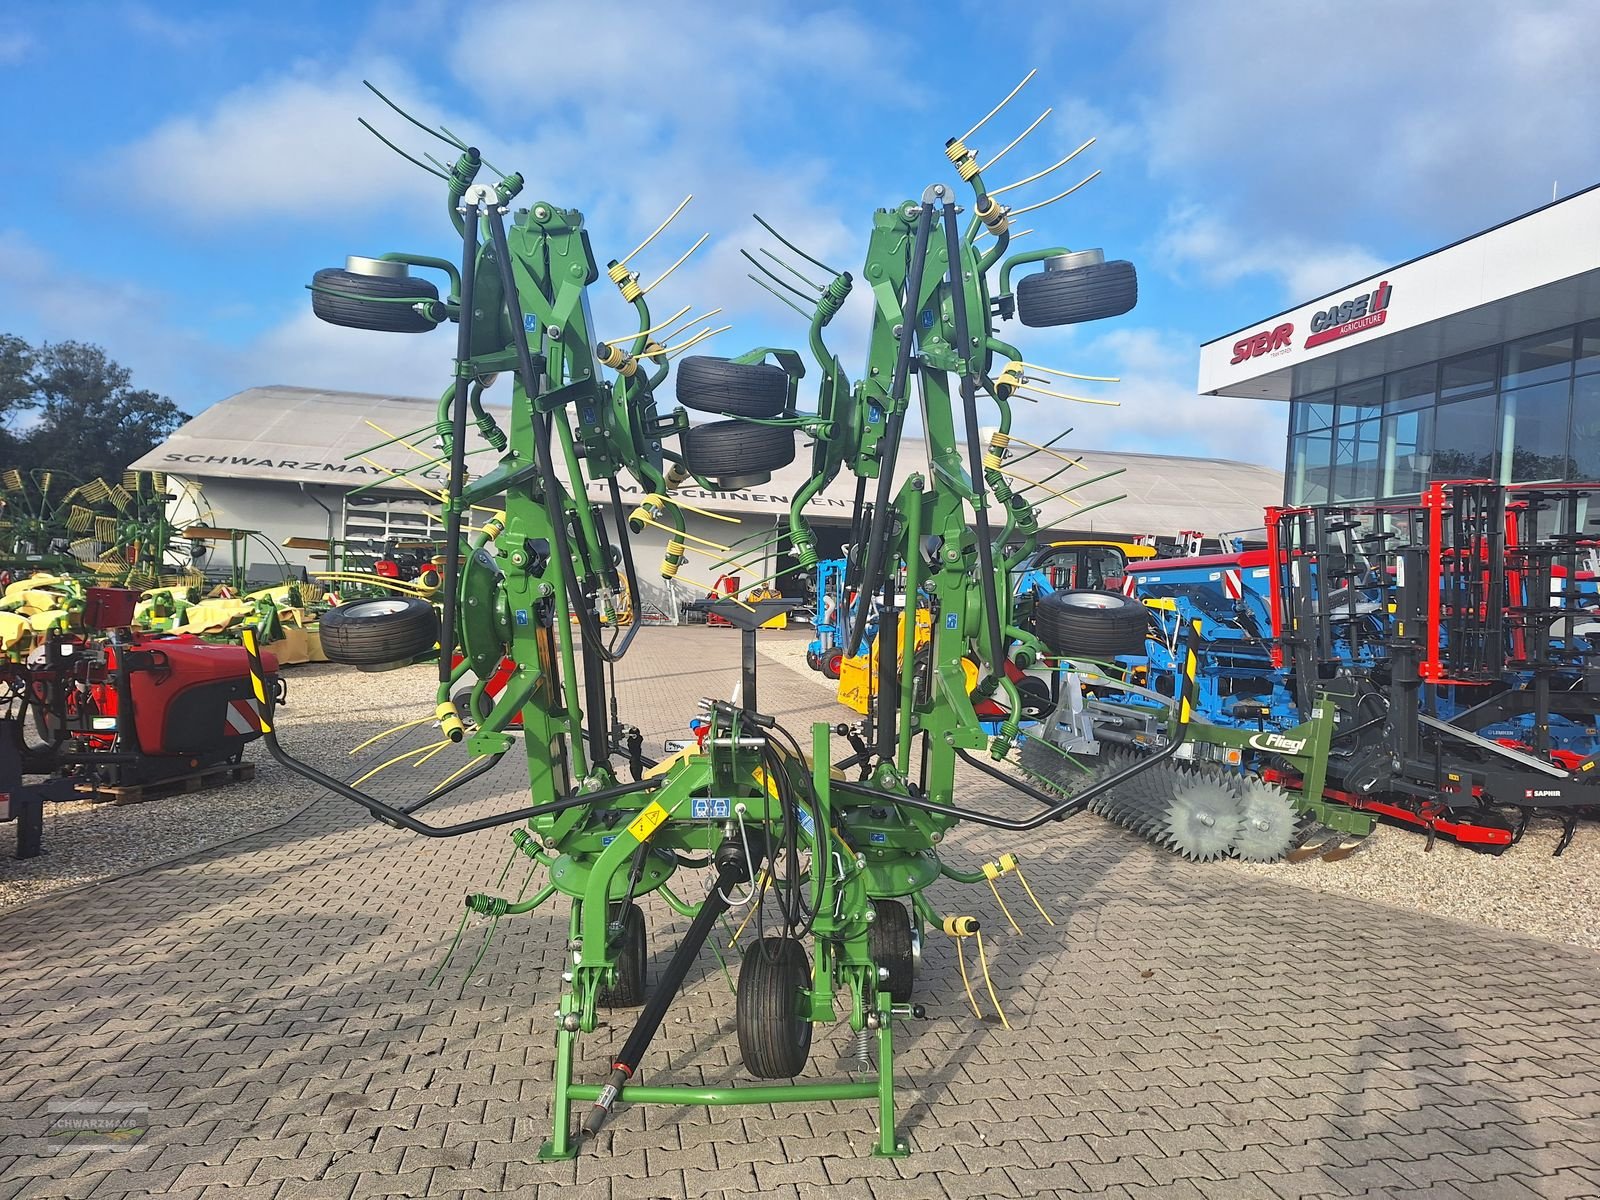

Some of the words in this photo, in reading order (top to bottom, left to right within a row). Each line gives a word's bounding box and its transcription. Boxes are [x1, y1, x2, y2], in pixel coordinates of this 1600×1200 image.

[1310, 293, 1370, 333] CASE
[1339, 311, 1382, 335] AGRICULTURE
[1230, 322, 1294, 365] STEYR
[1265, 734, 1307, 755] Fliegl
